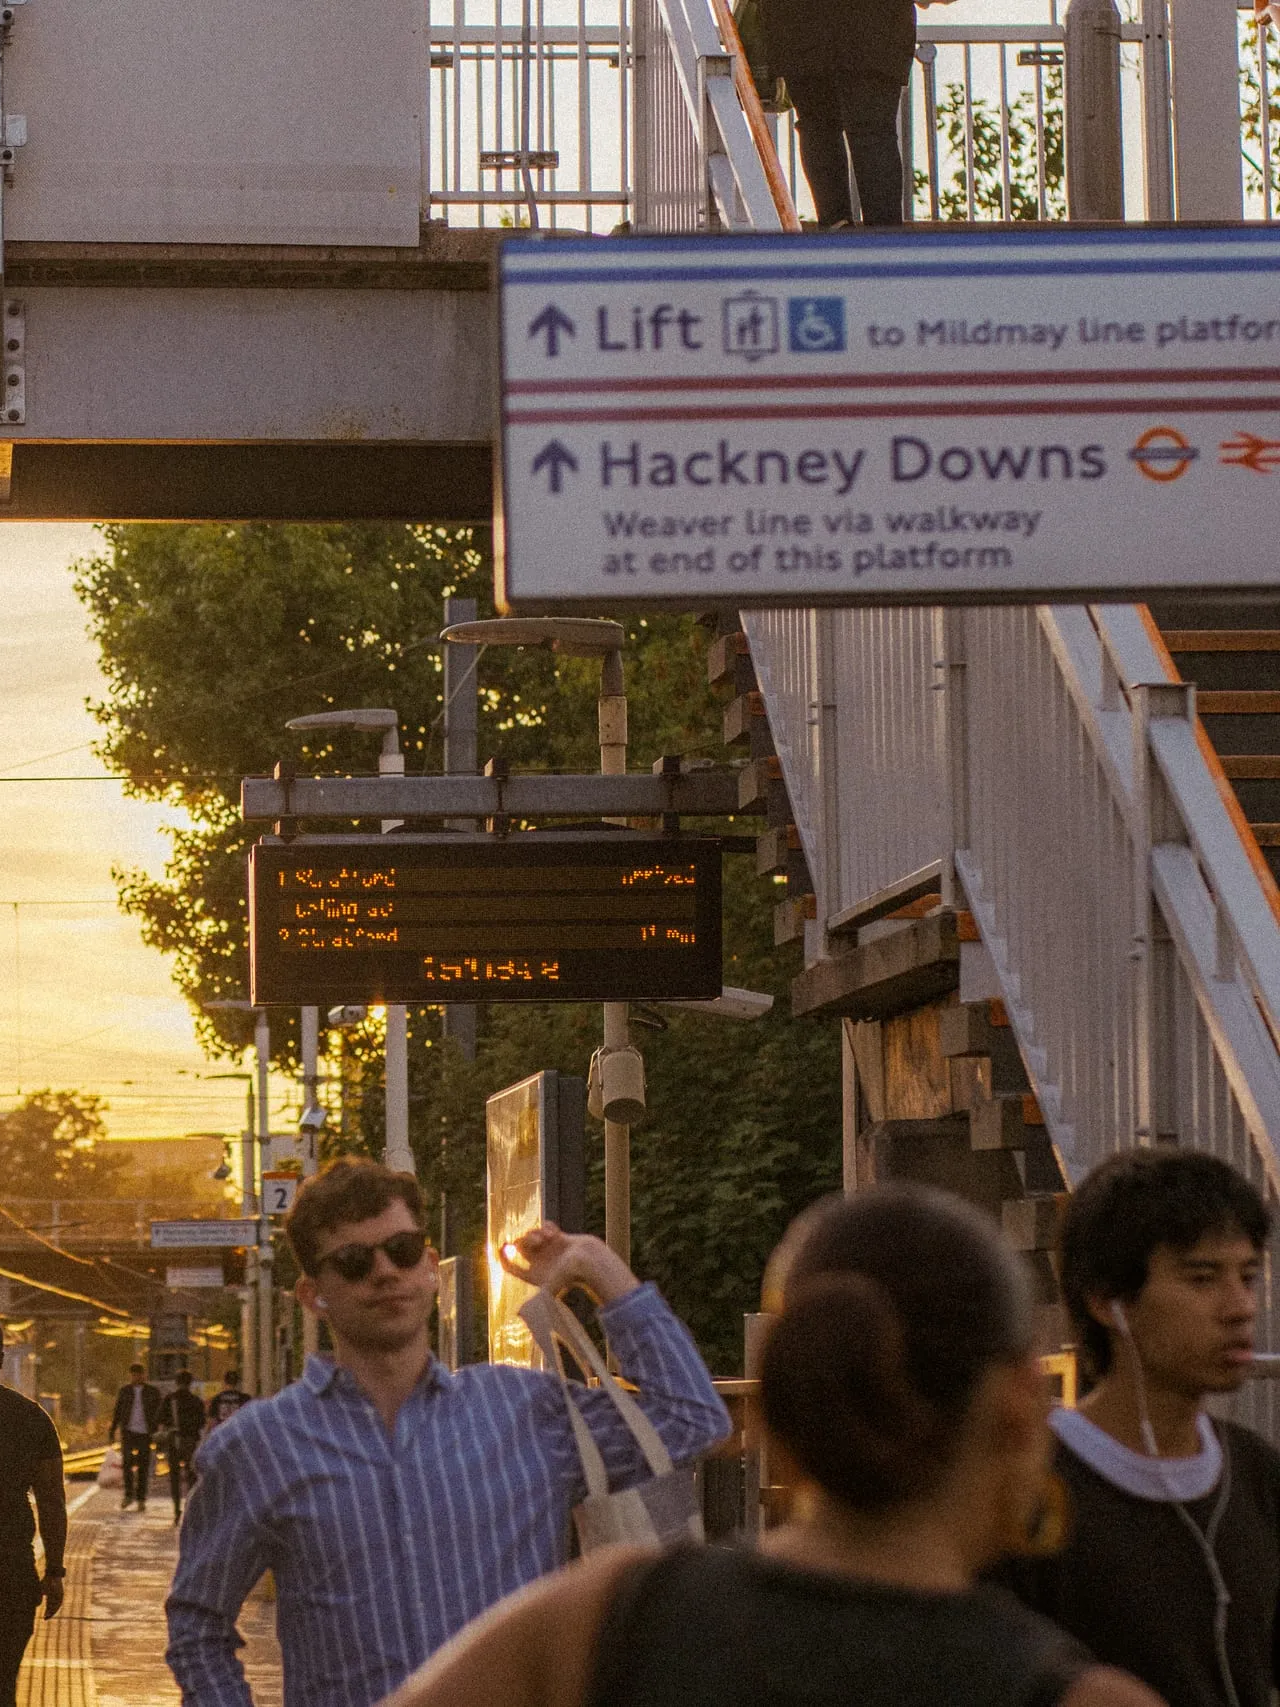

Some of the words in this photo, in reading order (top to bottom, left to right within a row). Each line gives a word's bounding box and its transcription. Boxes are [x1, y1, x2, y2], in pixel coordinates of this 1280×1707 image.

[596, 303, 703, 351] Lift
[867, 323, 906, 347] to
[919, 317, 1067, 351] Mildmay
[1076, 316, 1146, 344] line
[599, 440, 865, 496] Hackney
[890, 435, 1107, 483] Downs
[601, 510, 731, 539] Weaver
[744, 507, 811, 537] line
[823, 506, 875, 535] via
[884, 505, 1042, 537] walkway
[601, 551, 637, 575] at
[647, 547, 716, 575] end
[727, 545, 764, 574] of
[774, 544, 843, 573] this
[852, 541, 1012, 577] platform
[274, 1187, 289, 1209] 2
